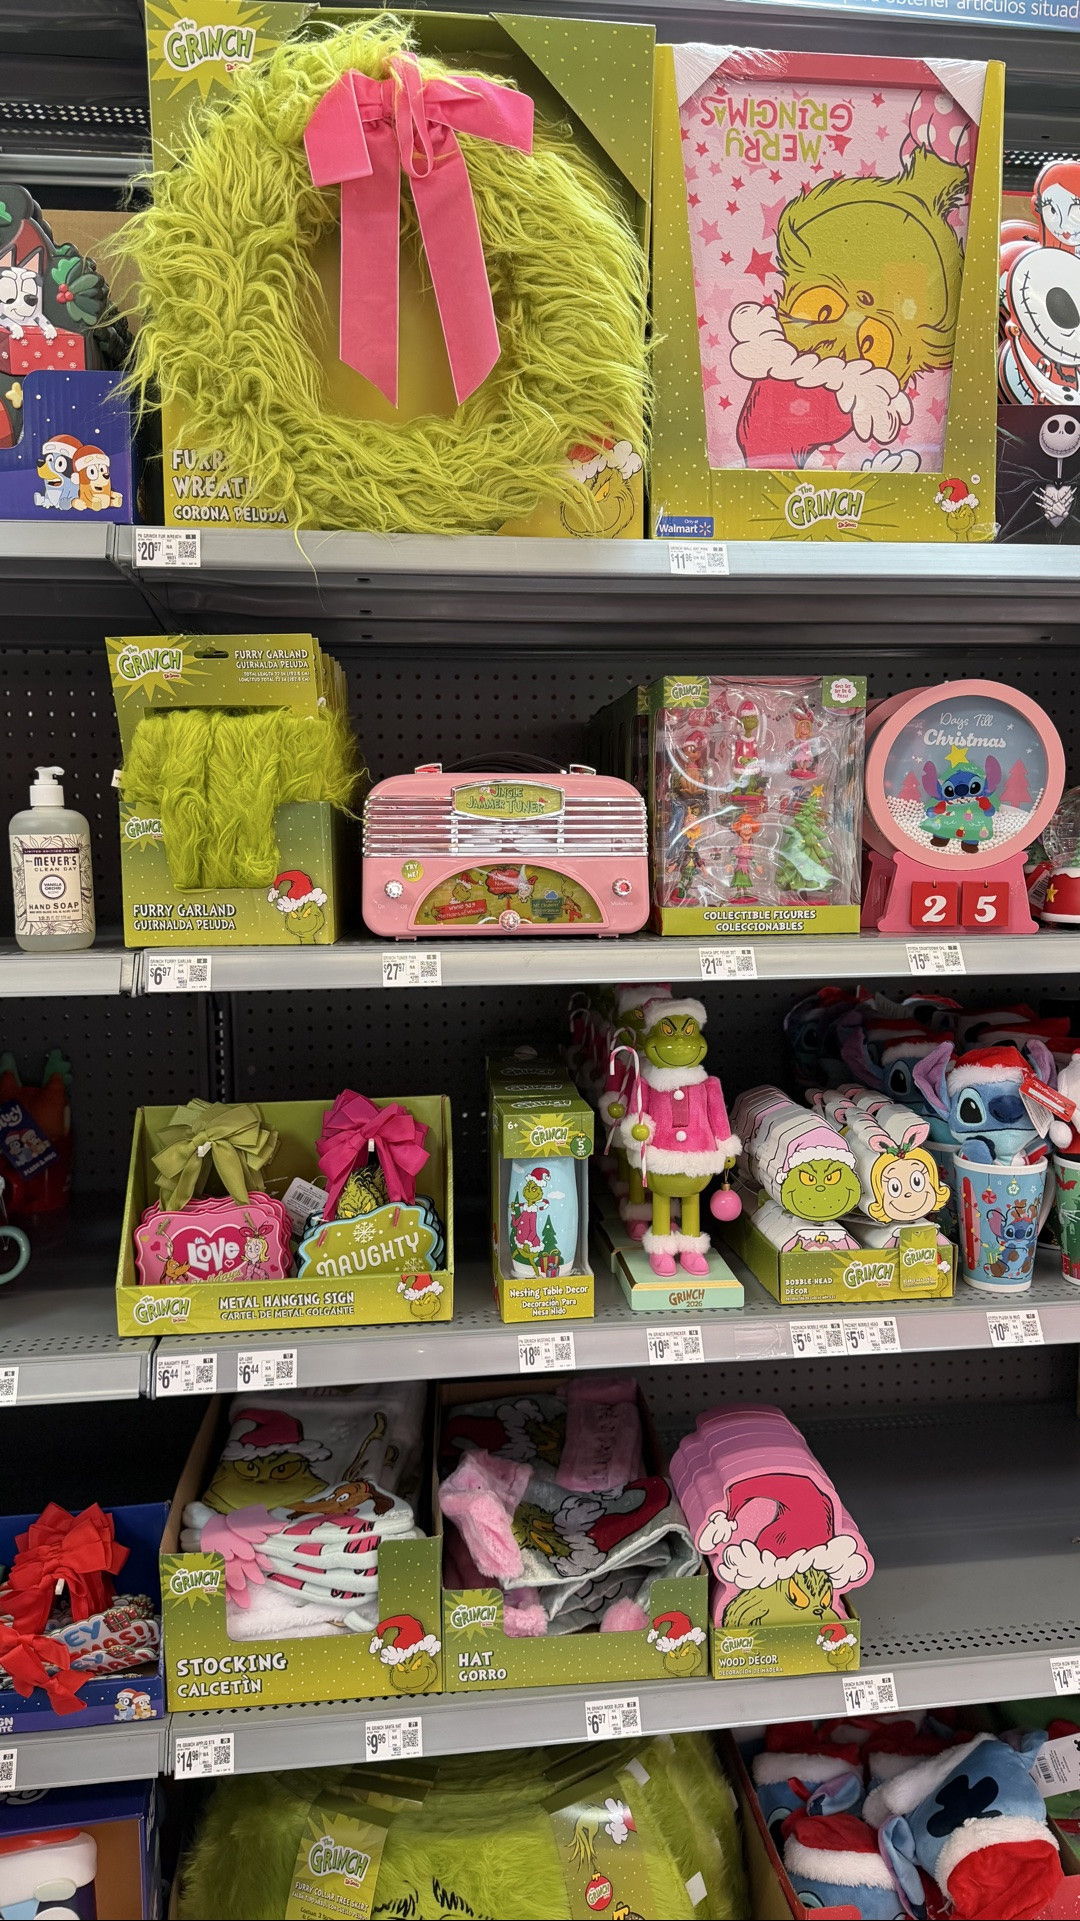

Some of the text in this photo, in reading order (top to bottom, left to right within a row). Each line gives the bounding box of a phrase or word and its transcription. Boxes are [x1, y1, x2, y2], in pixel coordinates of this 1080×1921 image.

[1030, 0, 1080, 19] situad
[178, 21, 195, 32] The
[166, 27, 254, 68] GRINCH
[700, 96, 854, 133] GRINCHMAS
[725, 127, 822, 164] MERRY
[171, 448, 232, 471] FURR
[799, 486, 813, 494] The
[173, 505, 289, 523] CORONA PELUDA
[787, 492, 863, 526] GRINCH
[659, 524, 698, 534] Walmart
[234, 649, 309, 660] FURRY GARLAND
[118, 649, 182, 679] GRINCH
[236, 660, 309, 669] GUIRNALDA PELUDA
[671, 686, 702, 700] GRINCH
[939, 712, 994, 728] Days Till
[923, 728, 1007, 749] Christmas
[507, 799, 545, 814] TUNER
[34, 856, 77, 867] MEYER'S
[405, 863, 418, 872] TRY
[406, 870, 420, 879] ME!
[53, 902, 79, 910] SOAP
[133, 904, 236, 917] FURRY GARLAND
[921, 895, 998, 923] 2 5
[703, 909, 817, 921] COLLECTIBLE FIGURES
[133, 919, 236, 931] GUIRNALDA PELUDA
[715, 921, 804, 932] COLECCIONABLES
[507, 1121, 519, 1130] 6+
[530, 1128, 568, 1145] GRINCH
[578, 1141, 585, 1150] 5
[316, 1231, 420, 1277] NAUGHTY
[903, 1249, 936, 1266] GRINCH
[785, 1277, 833, 1286] BOBBLE-HEAD
[845, 1264, 894, 1287] GRINCH
[510, 1285, 589, 1299] Nesting Table Decor
[668, 1289, 705, 1306] GRINCH
[785, 1286, 808, 1295] DÉCOR
[218, 1291, 355, 1310] METAL HANGING SIGN
[522, 1298, 577, 1308] Decoración Para
[134, 1298, 191, 1324] GRINCH
[221, 1305, 355, 1320] CARTEL DE METAL COLGANTE
[551, 1307, 566, 1315] Nido
[170, 1571, 220, 1594] GRINCH
[450, 1606, 496, 1628] GRINCH
[57, 1620, 101, 1647] EY
[721, 1638, 753, 1653] GRINCH
[176, 1652, 288, 1677] STOCKING
[458, 1651, 493, 1667] HAT
[718, 1652, 778, 1668] WOOD DÉCOR
[458, 1668, 507, 1682] GORRO
[310, 1844, 369, 1879] GRINCH
[295, 1881, 314, 1894] FURRY
[314, 1887, 335, 1902] COLLAR
[336, 1895, 350, 1908] TREE
[351, 1900, 369, 1914] SKIRT
[587, 1883, 611, 1905] GRINCH
